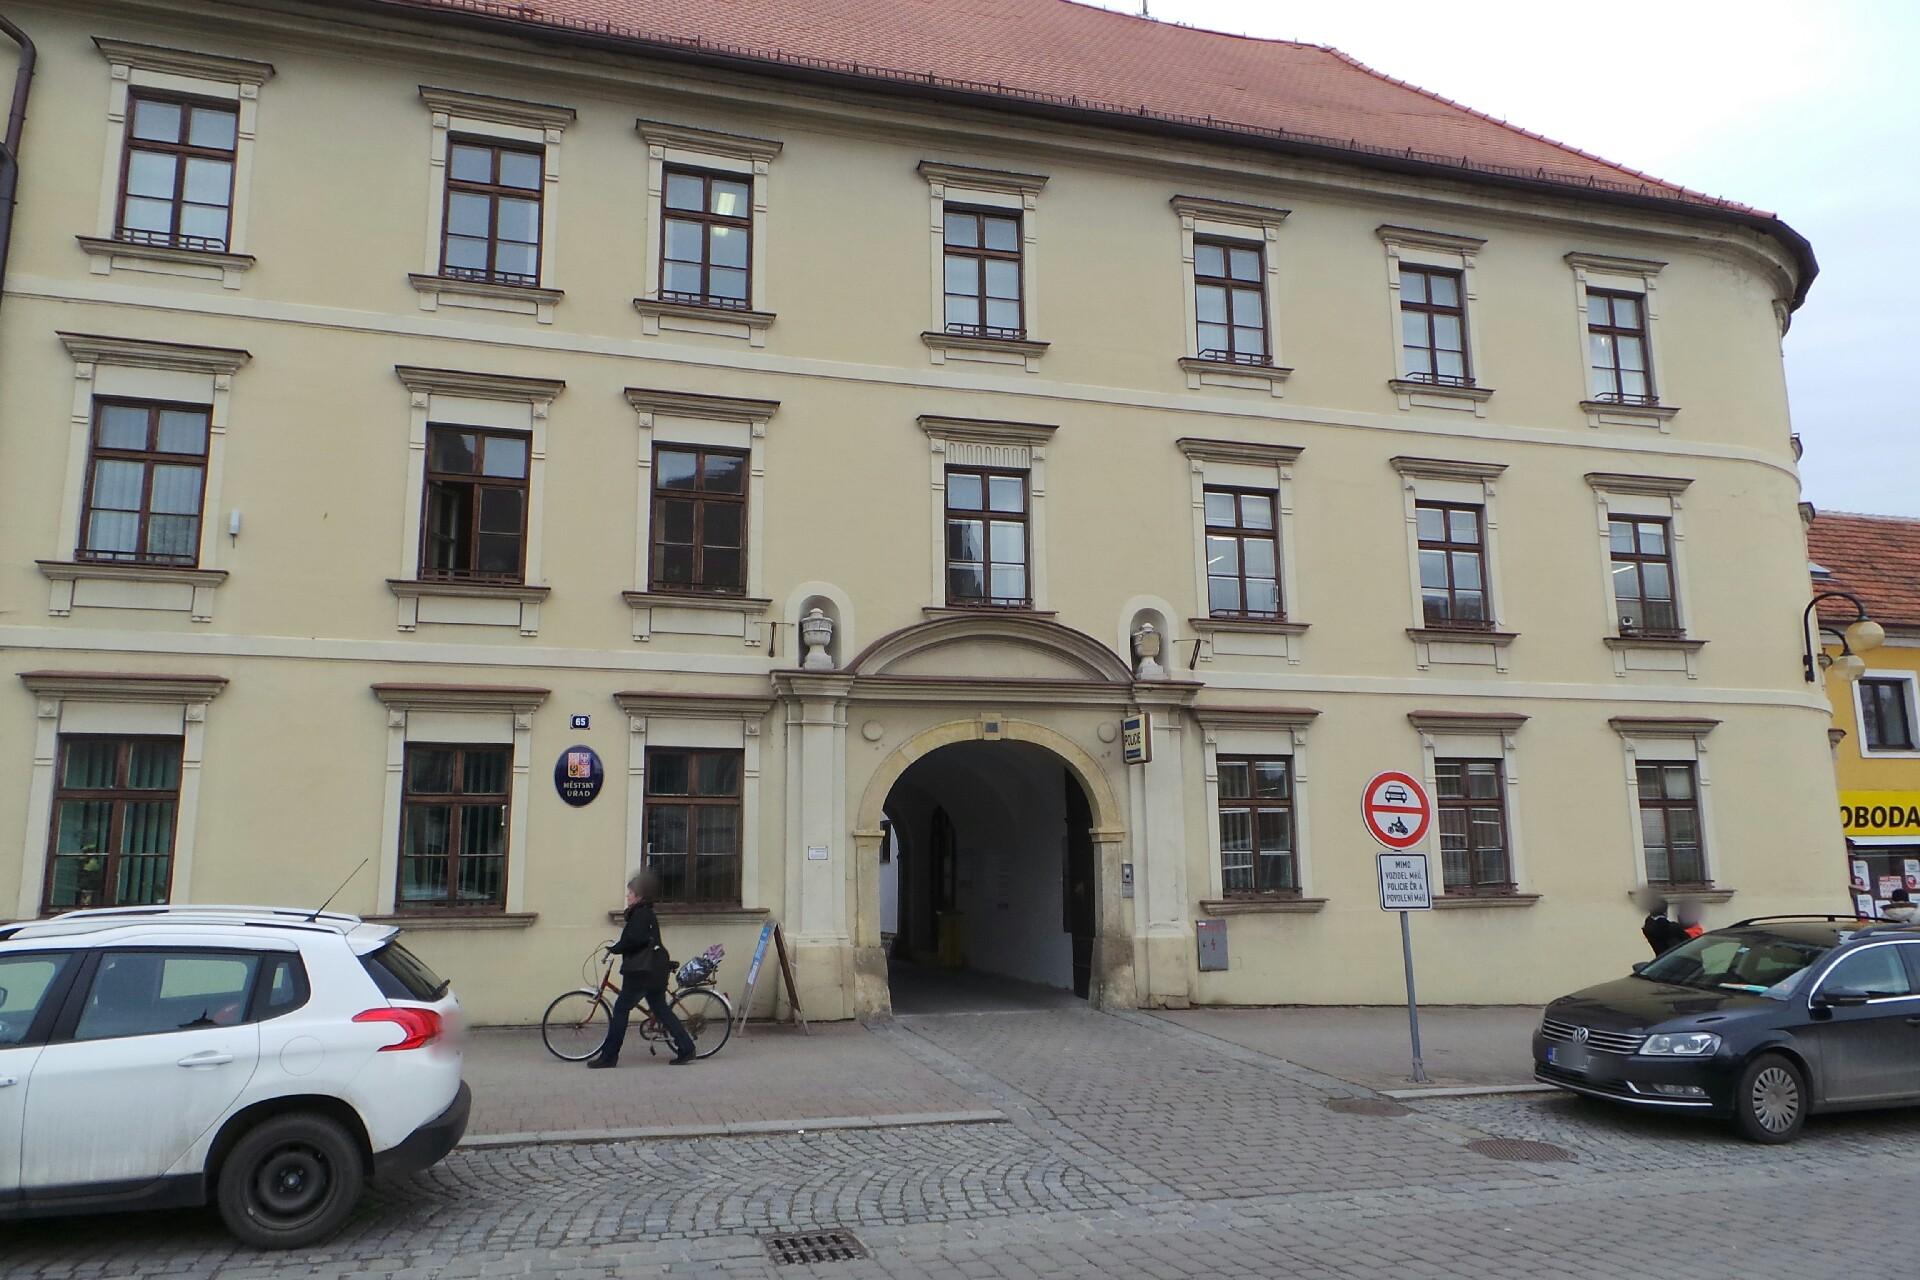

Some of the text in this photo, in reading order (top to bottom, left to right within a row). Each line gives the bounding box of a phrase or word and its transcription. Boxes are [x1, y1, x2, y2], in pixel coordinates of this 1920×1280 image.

[575, 717, 586, 726] 65
[1125, 731, 1141, 747] POLICIE
[1395, 860, 1411, 869] MIMO
[1385, 871, 1408, 880] VOZIDEL
[1387, 882, 1409, 891] POLICIE
